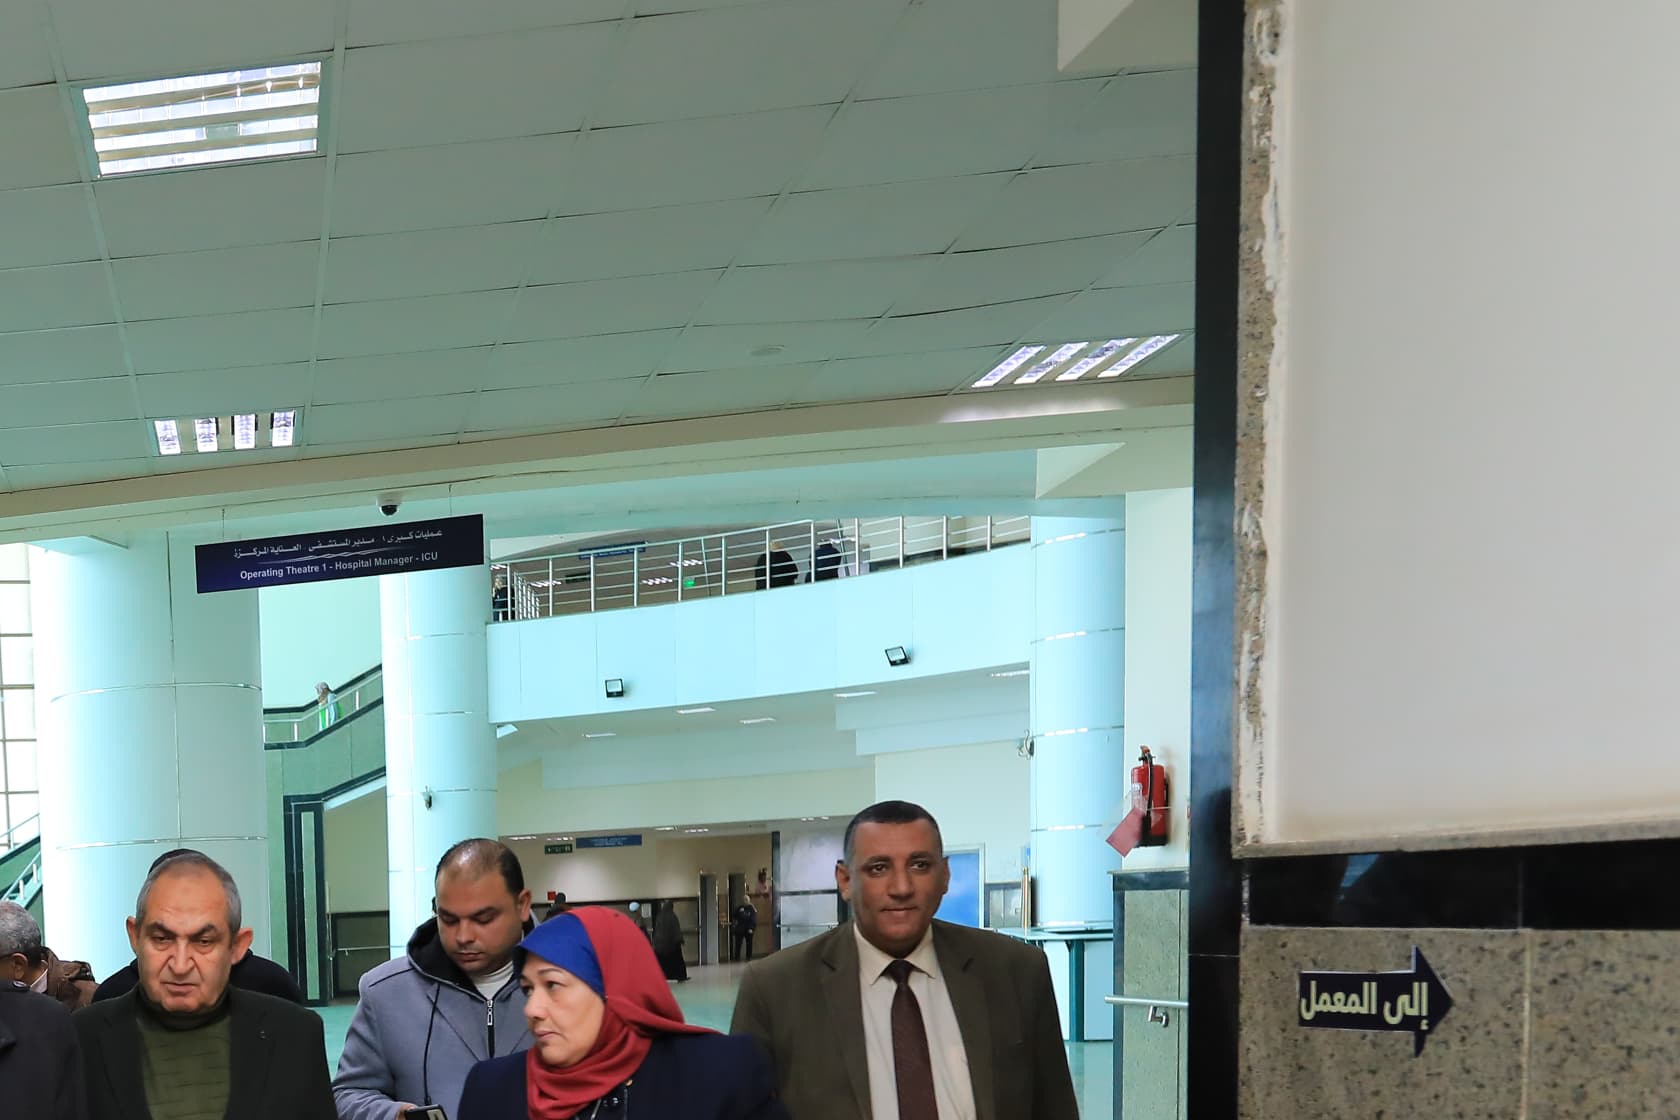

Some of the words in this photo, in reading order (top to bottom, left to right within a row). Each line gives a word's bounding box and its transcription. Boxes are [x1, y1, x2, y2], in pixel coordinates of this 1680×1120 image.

[240, 567, 284, 581] Operating
[285, 562, 320, 575] Theatre
[321, 563, 327, 572] 1
[335, 558, 372, 571] Hospital
[374, 554, 414, 567] Manager
[421, 551, 438, 562] ICU
[1301, 980, 1377, 1020] المعمل
[1383, 981, 1429, 1030] إلى
